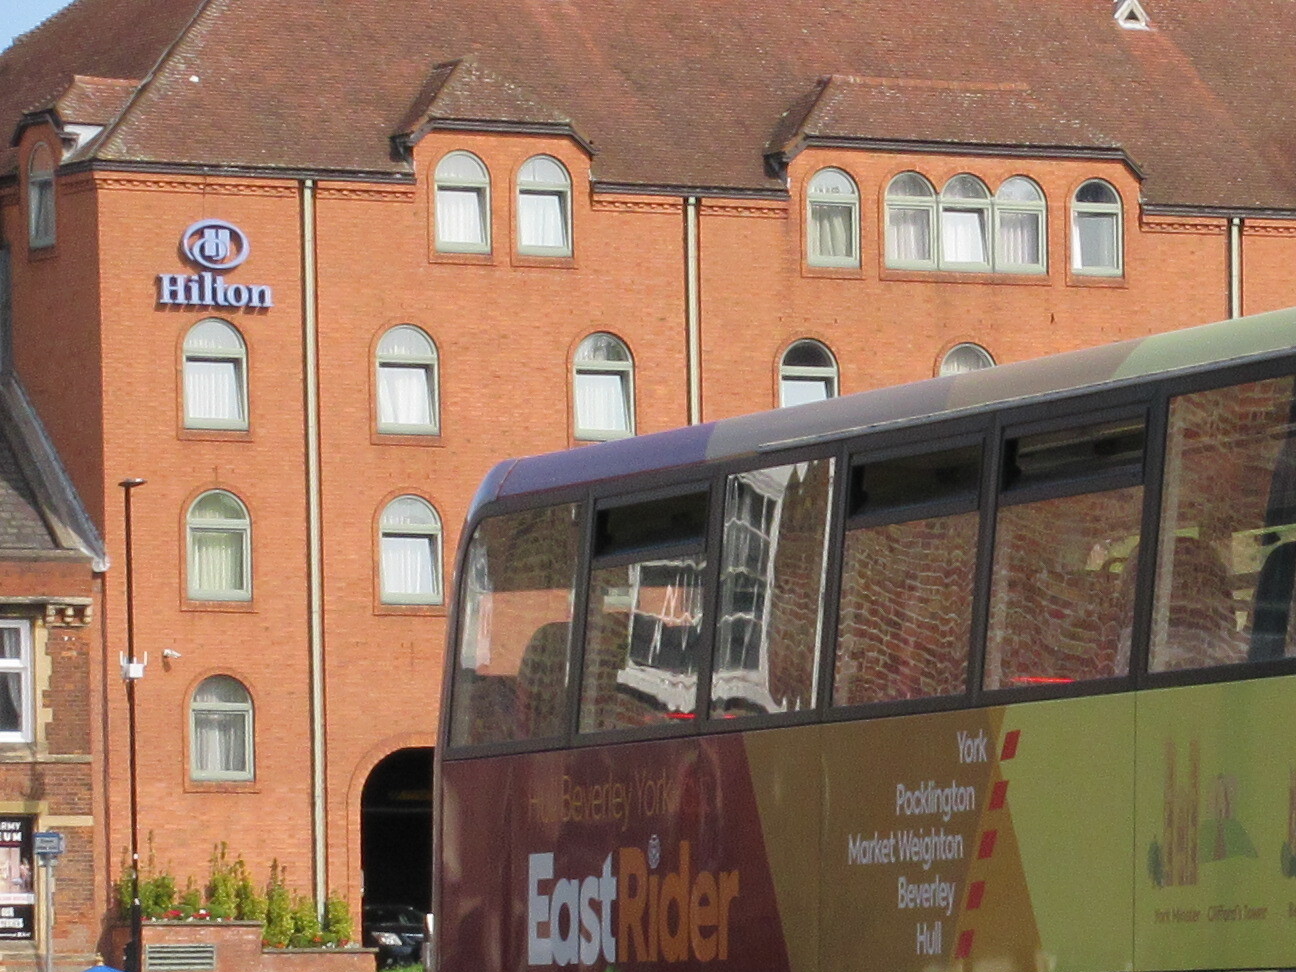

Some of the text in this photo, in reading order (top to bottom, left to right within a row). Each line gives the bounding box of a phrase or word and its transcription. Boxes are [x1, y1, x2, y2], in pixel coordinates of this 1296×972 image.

[159, 271, 275, 307] Hilton
[957, 729, 988, 763] York
[562, 770, 632, 832] Beverley
[634, 767, 671, 817] York
[896, 780, 975, 822] Pocklington
[848, 828, 964, 870] Market Weighton
[528, 838, 740, 967] EastRider
[898, 875, 956, 916] Beverley
[916, 921, 942, 954] Hull
